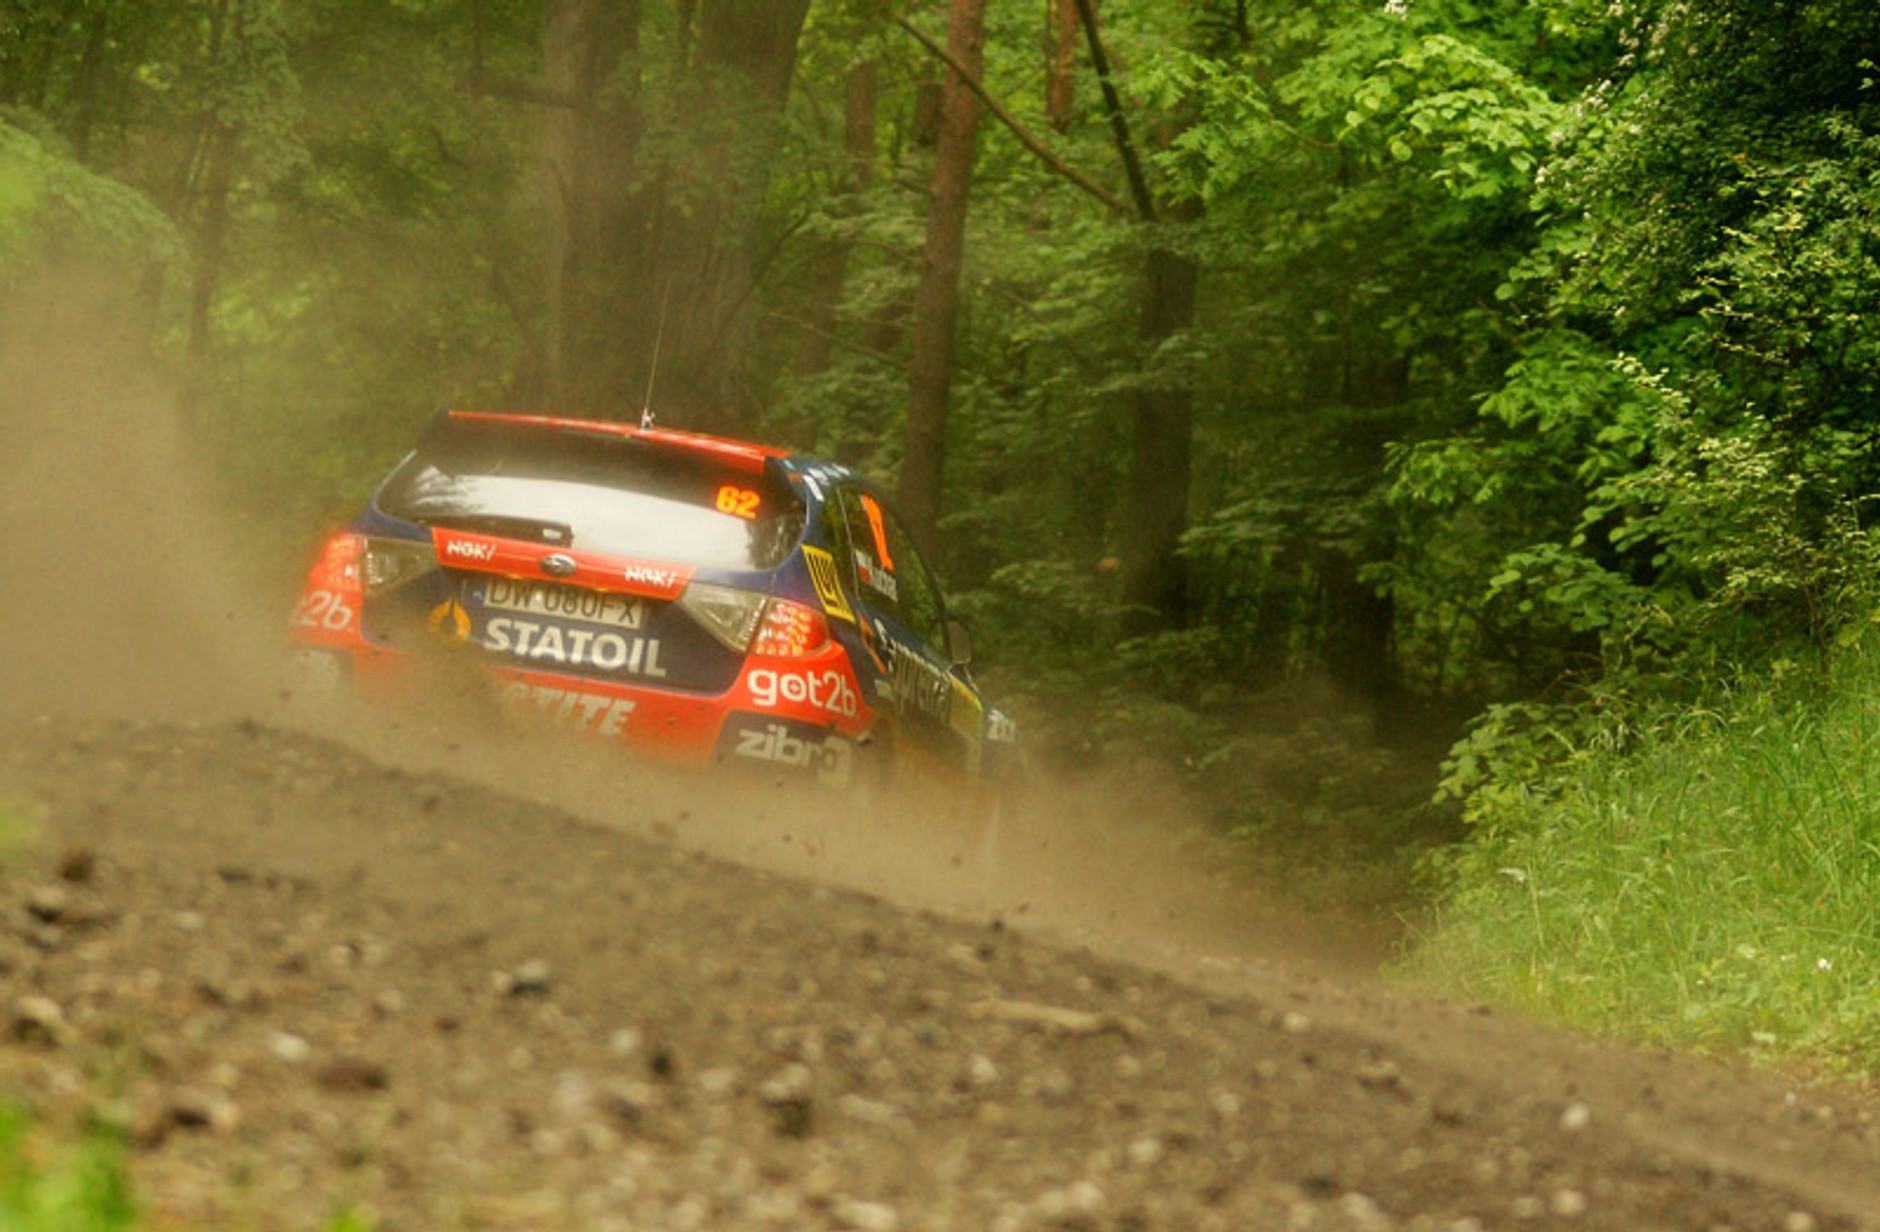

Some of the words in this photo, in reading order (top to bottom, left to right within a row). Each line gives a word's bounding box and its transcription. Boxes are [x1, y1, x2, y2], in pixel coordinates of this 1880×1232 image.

[716, 485, 760, 519] 62
[483, 617, 667, 678] STATOIL
[748, 668, 857, 717] got2b
